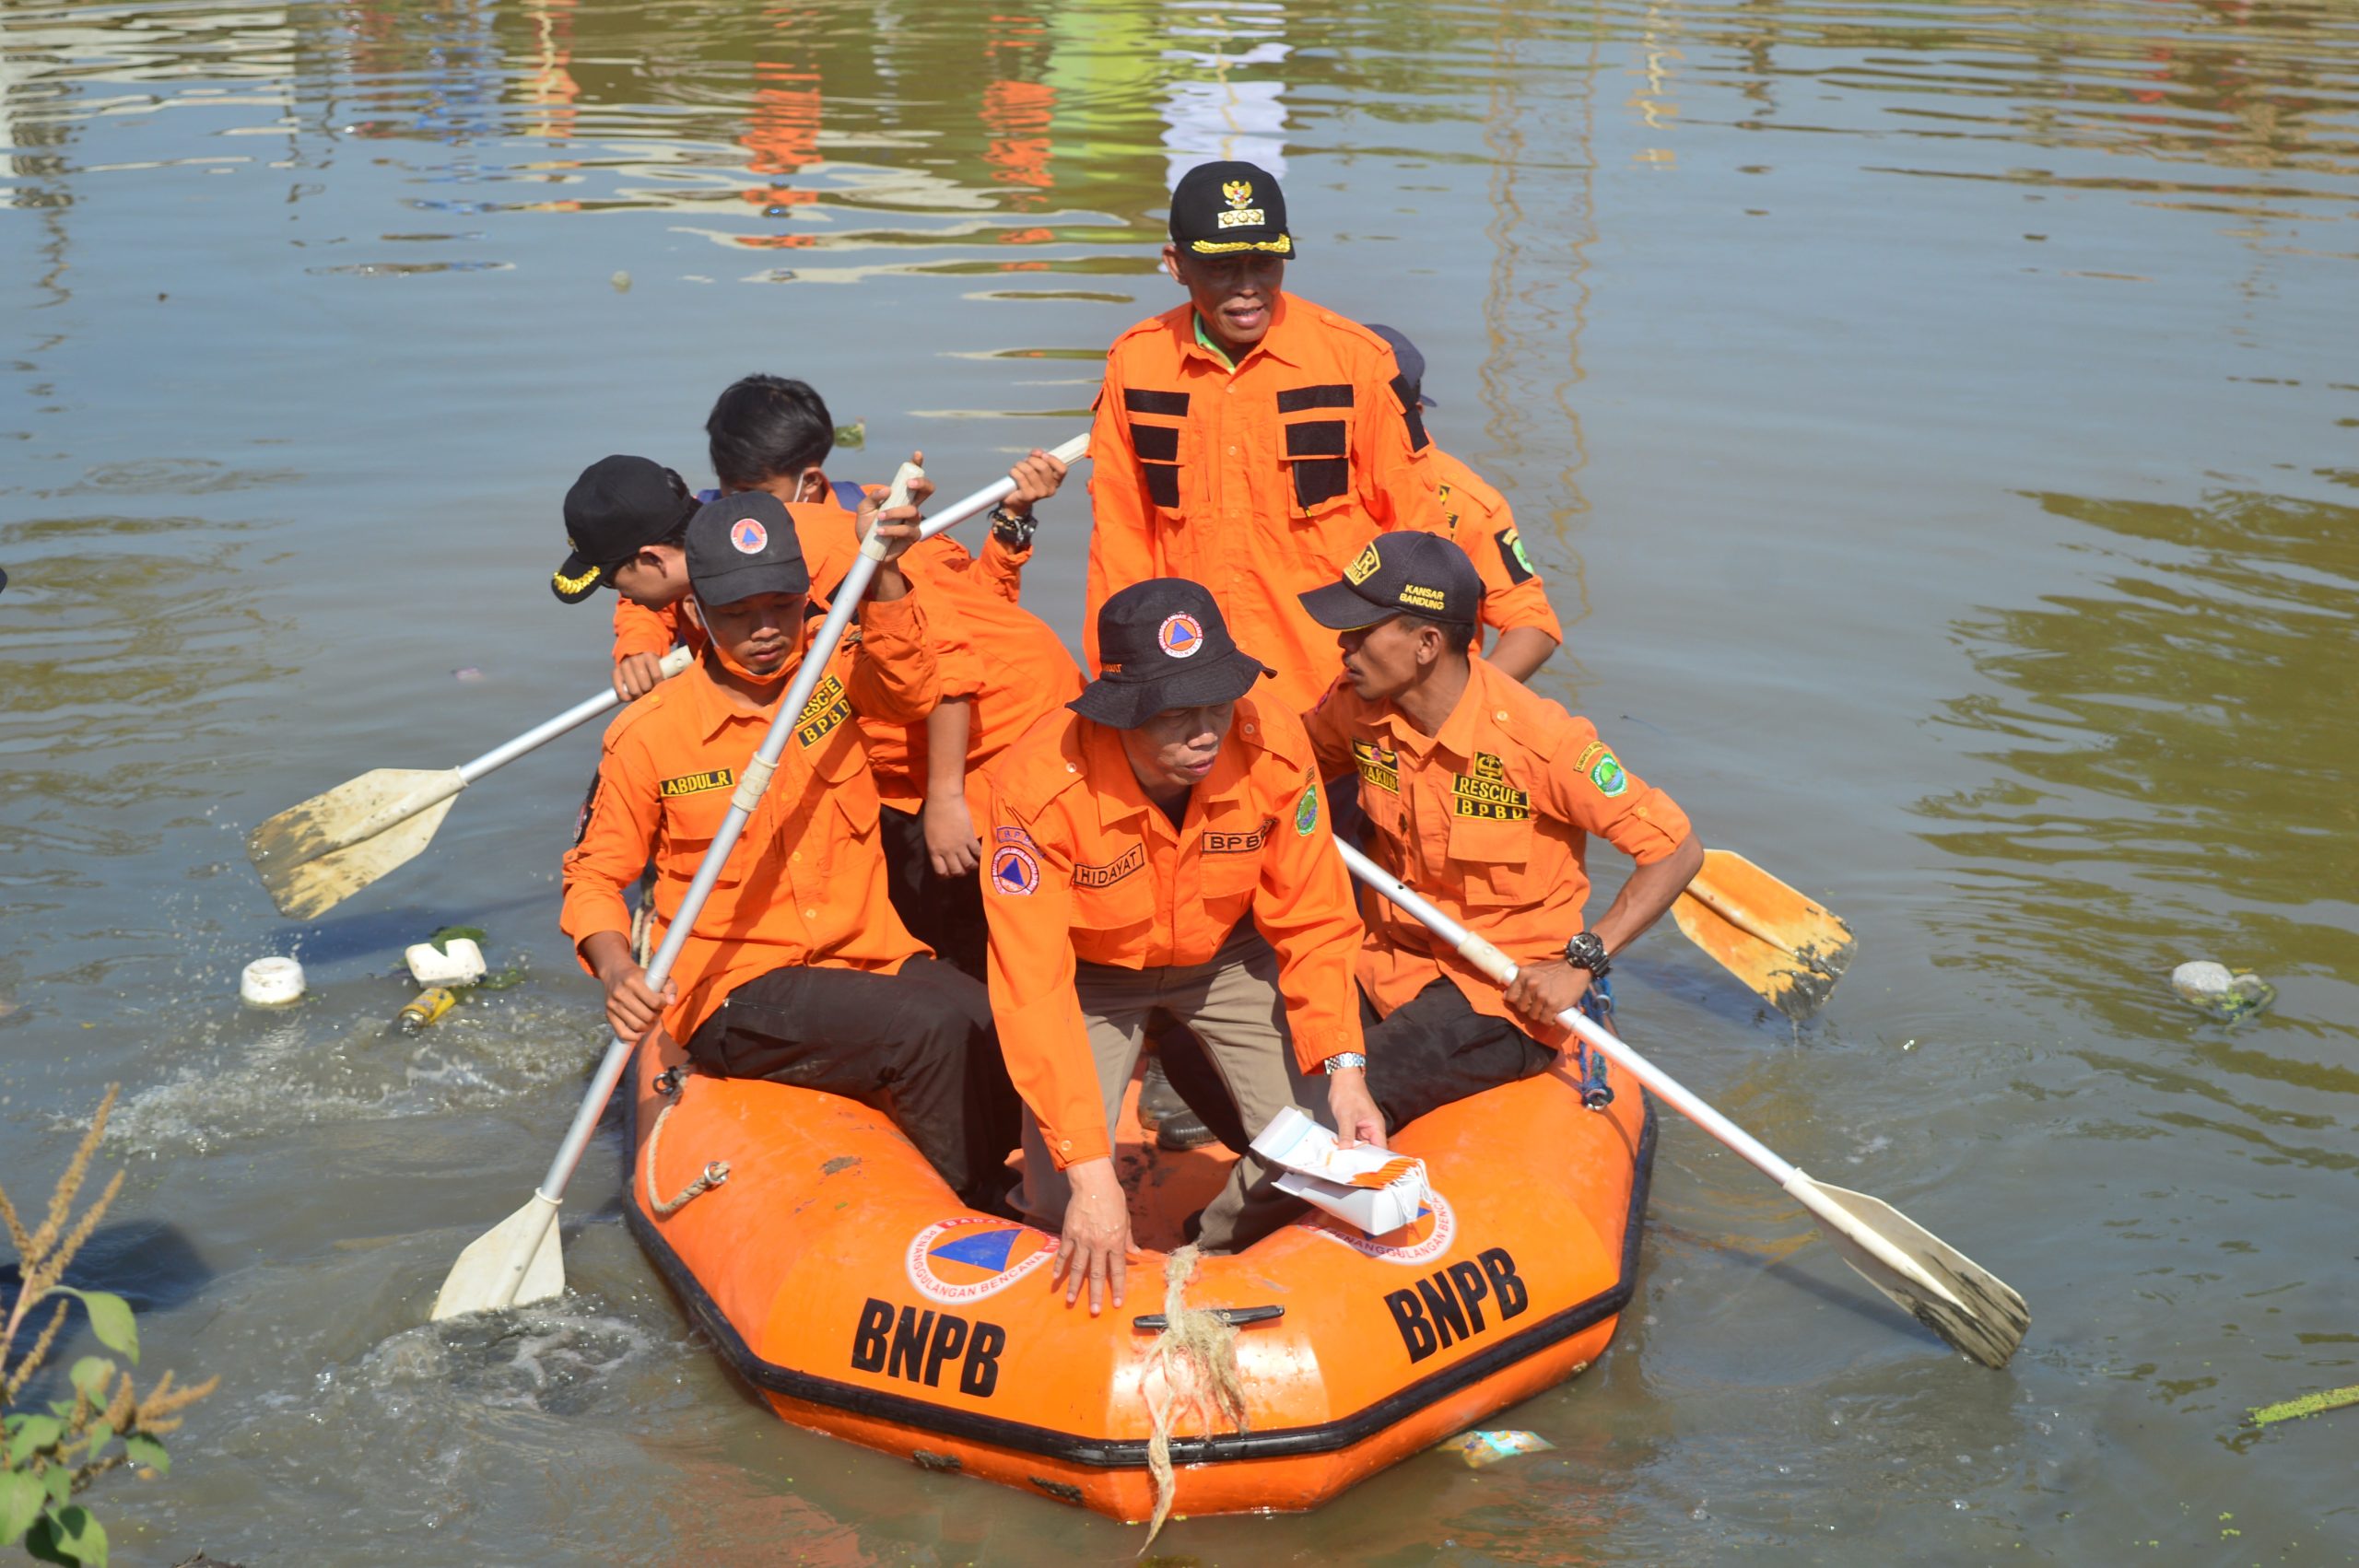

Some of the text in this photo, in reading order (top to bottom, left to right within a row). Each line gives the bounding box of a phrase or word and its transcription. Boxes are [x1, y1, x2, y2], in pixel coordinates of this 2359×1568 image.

[1400, 592, 1445, 610] BANDUNG
[1404, 583, 1445, 601] KANSAR
[797, 679, 839, 723] ESCE
[667, 770, 730, 794] ABDUL.R
[1459, 777, 1520, 804] RESCUE
[1461, 799, 1524, 819] BPBD
[1080, 850, 1136, 884] HIDAYAT
[913, 1230, 977, 1298] PENANGGULANGAN
[980, 1254, 1045, 1293] BENCANA
[1383, 1246, 1529, 1364] BNPB
[851, 1297, 1006, 1398] BNPB
